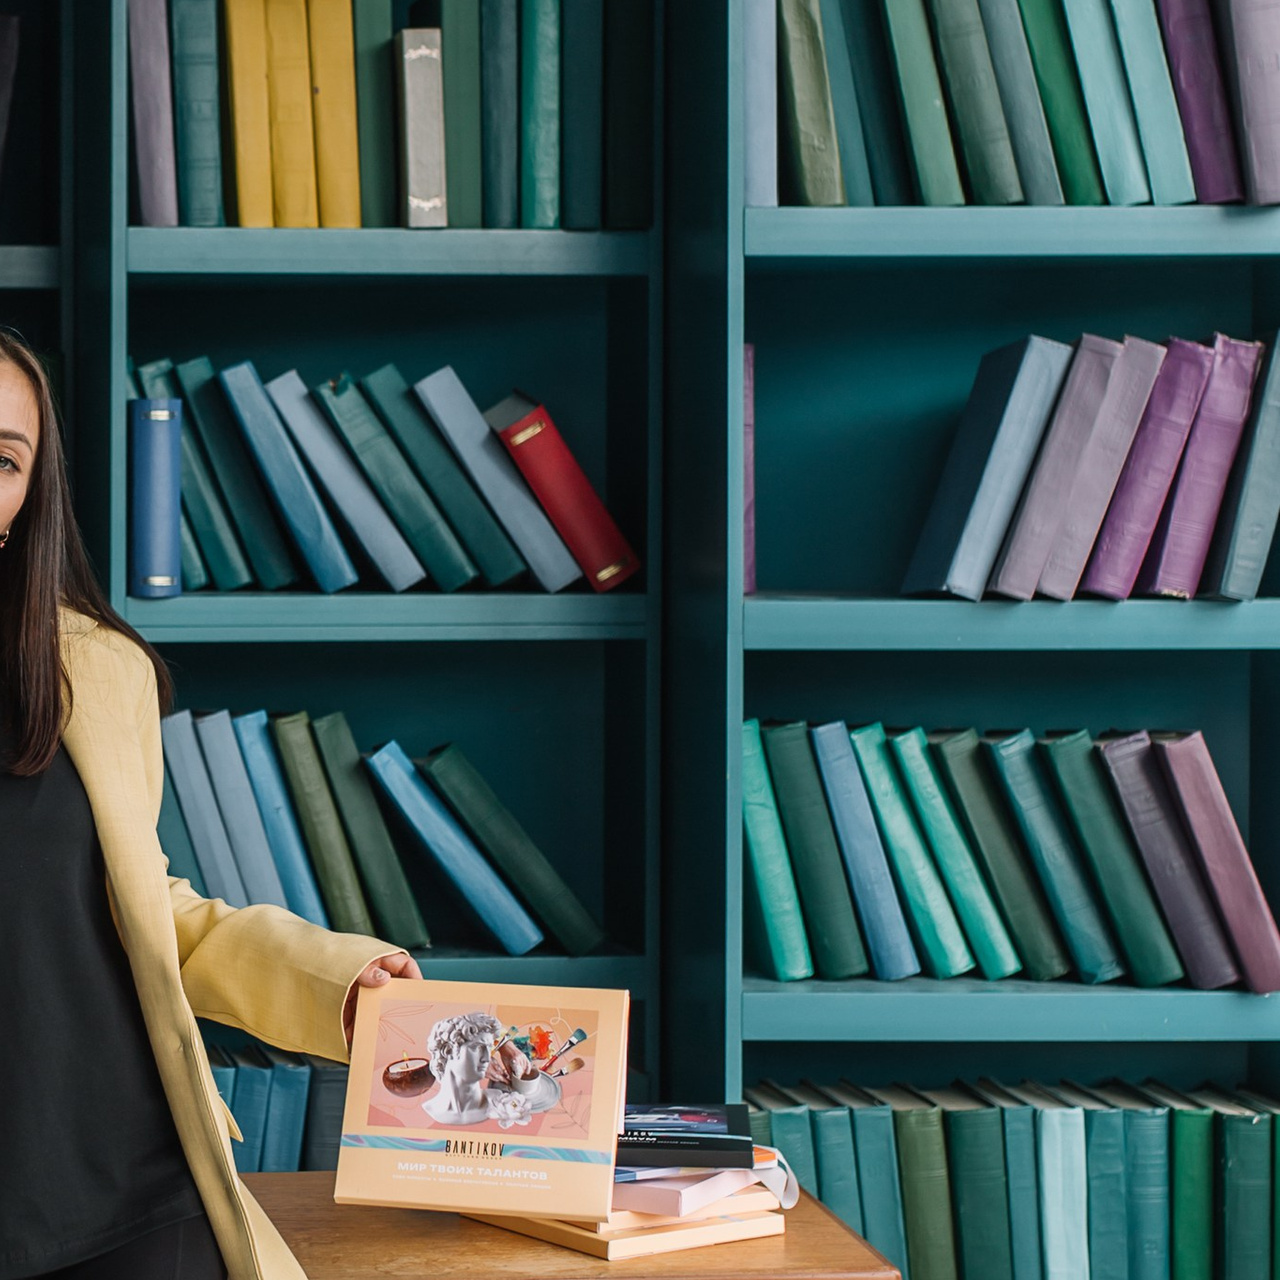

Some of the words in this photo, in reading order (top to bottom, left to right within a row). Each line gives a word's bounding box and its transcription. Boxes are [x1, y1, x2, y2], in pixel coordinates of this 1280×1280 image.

[445, 1140, 505, 1157] BANTIKOV
[397, 1161, 426, 1172] МИР
[430, 1163, 473, 1176] ТВОИХ
[477, 1167, 548, 1181] ТАЛАНТОВ
